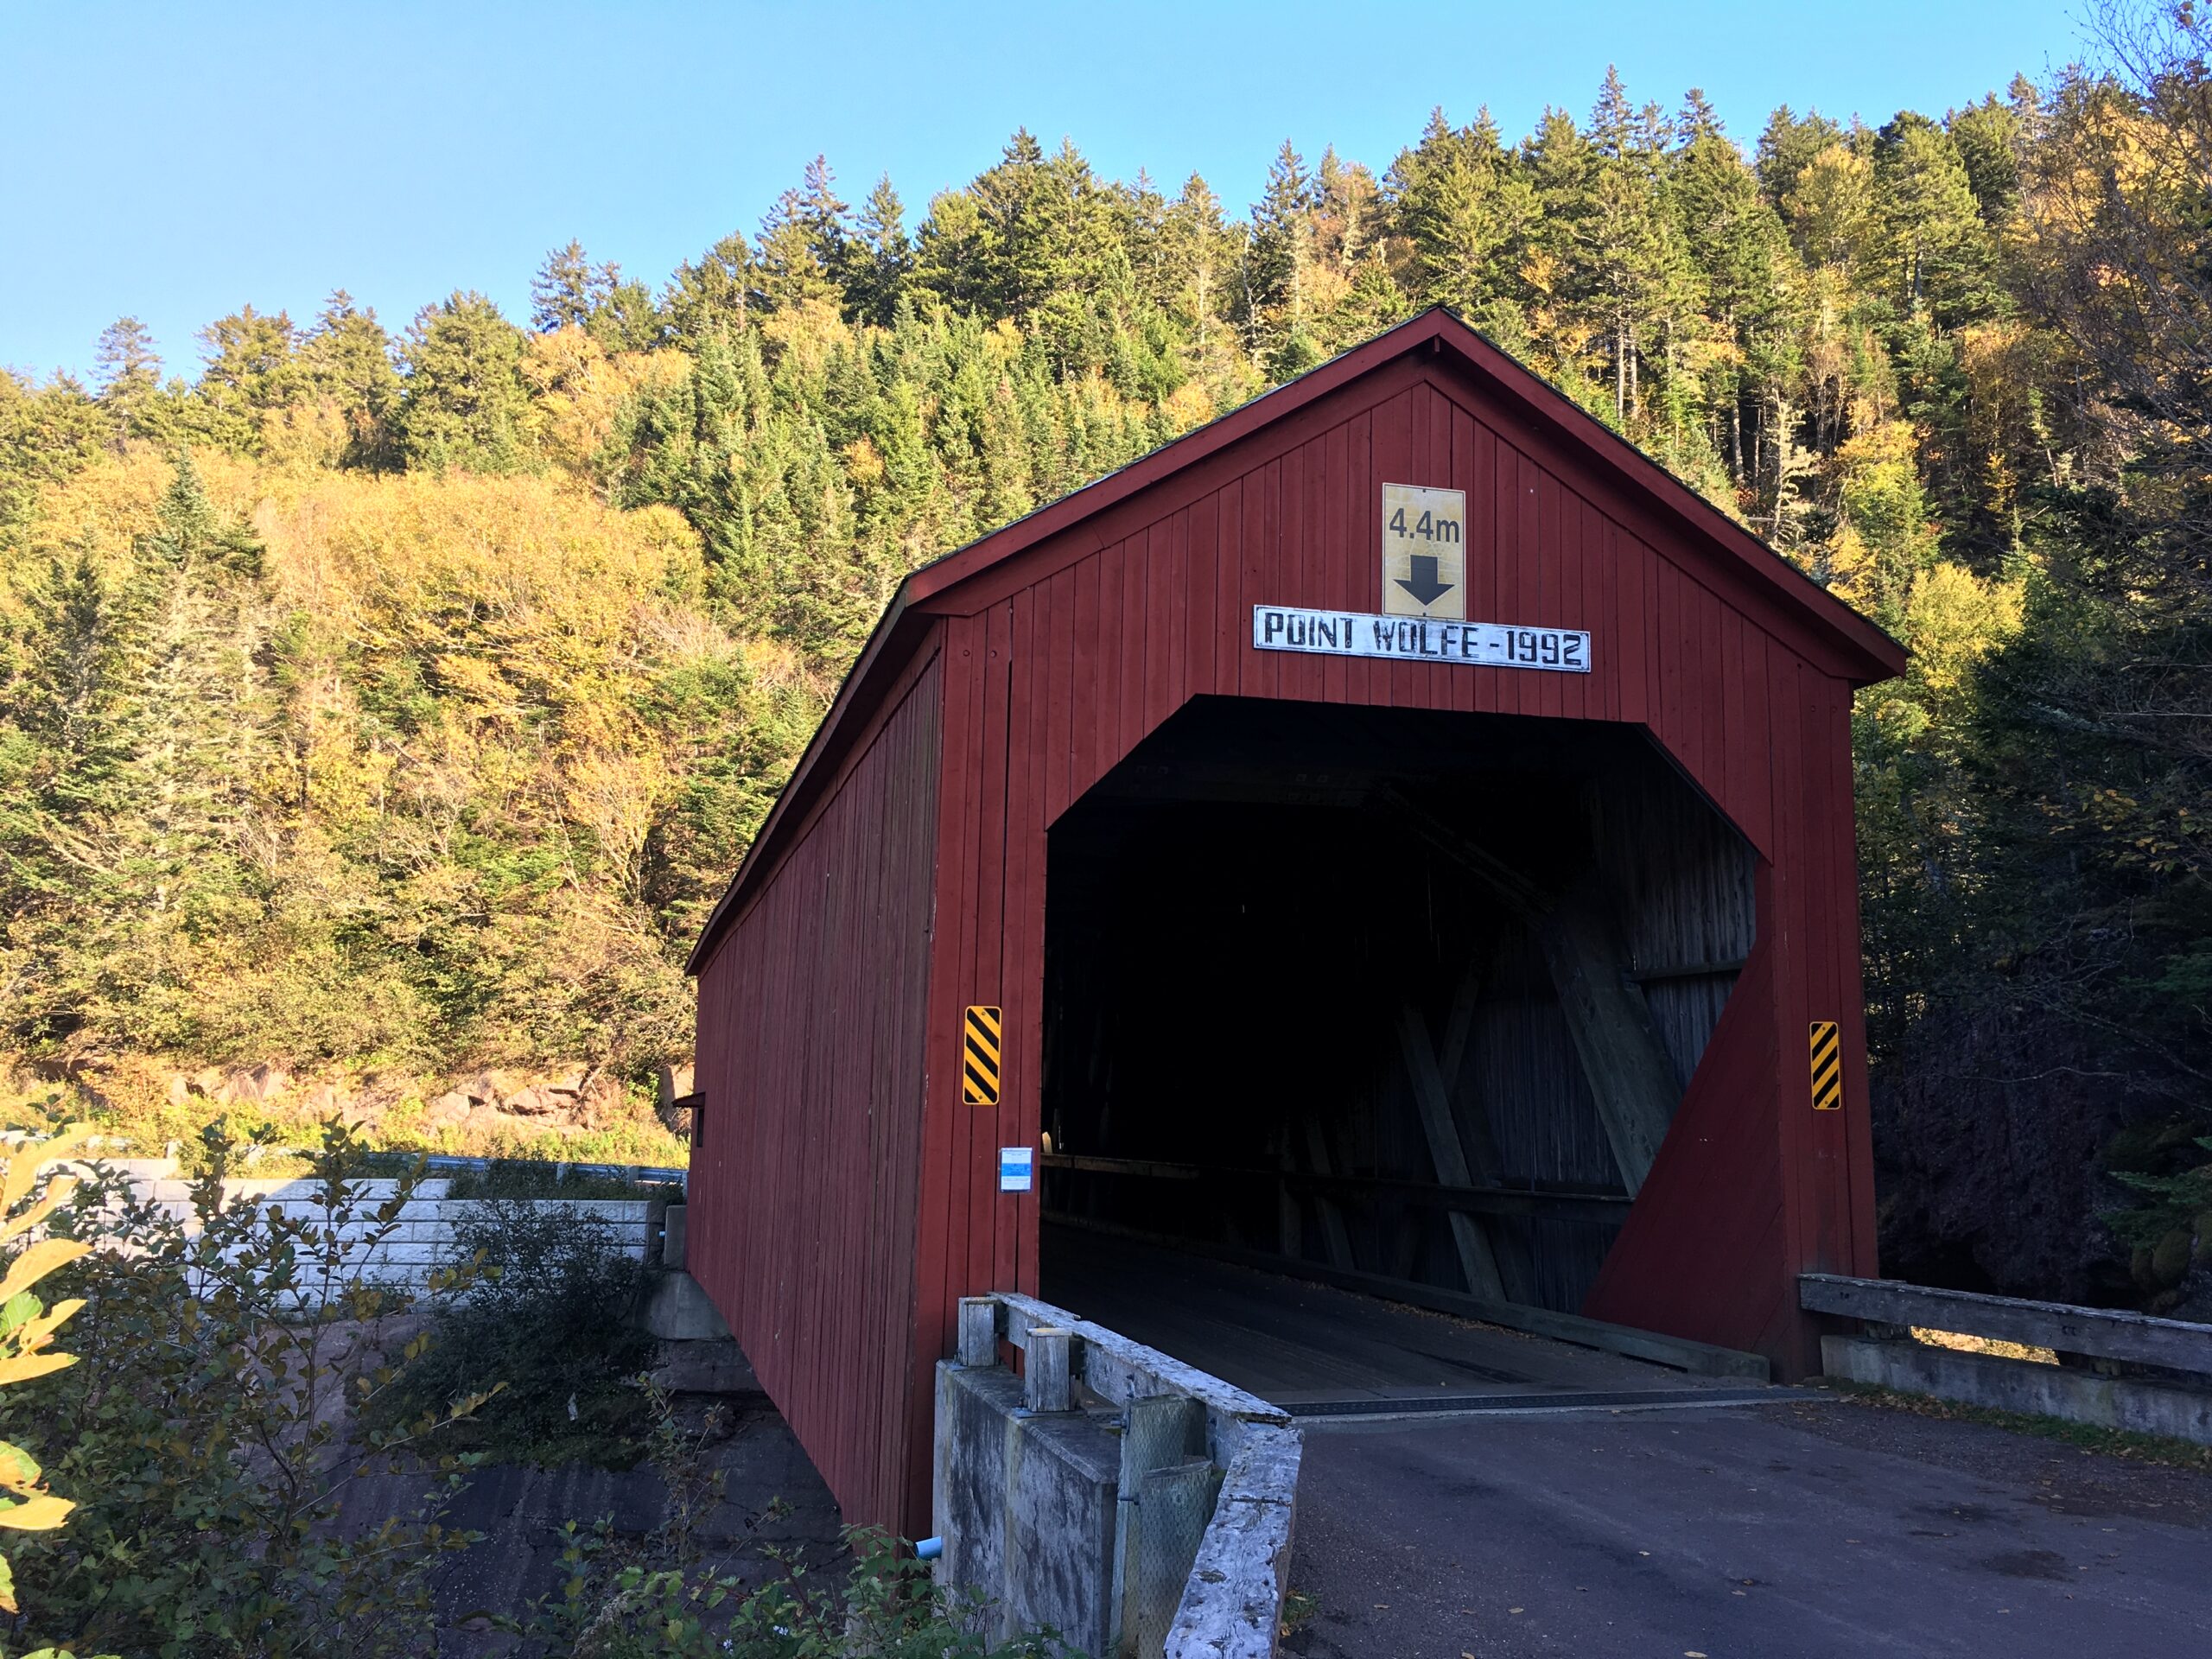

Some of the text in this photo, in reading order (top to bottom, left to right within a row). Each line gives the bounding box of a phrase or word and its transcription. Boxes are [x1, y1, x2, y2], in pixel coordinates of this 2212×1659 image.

[1389, 507, 1459, 543] 4.4m
[1265, 612, 1355, 648] POINT
[1373, 620, 1479, 658] WOLFE
